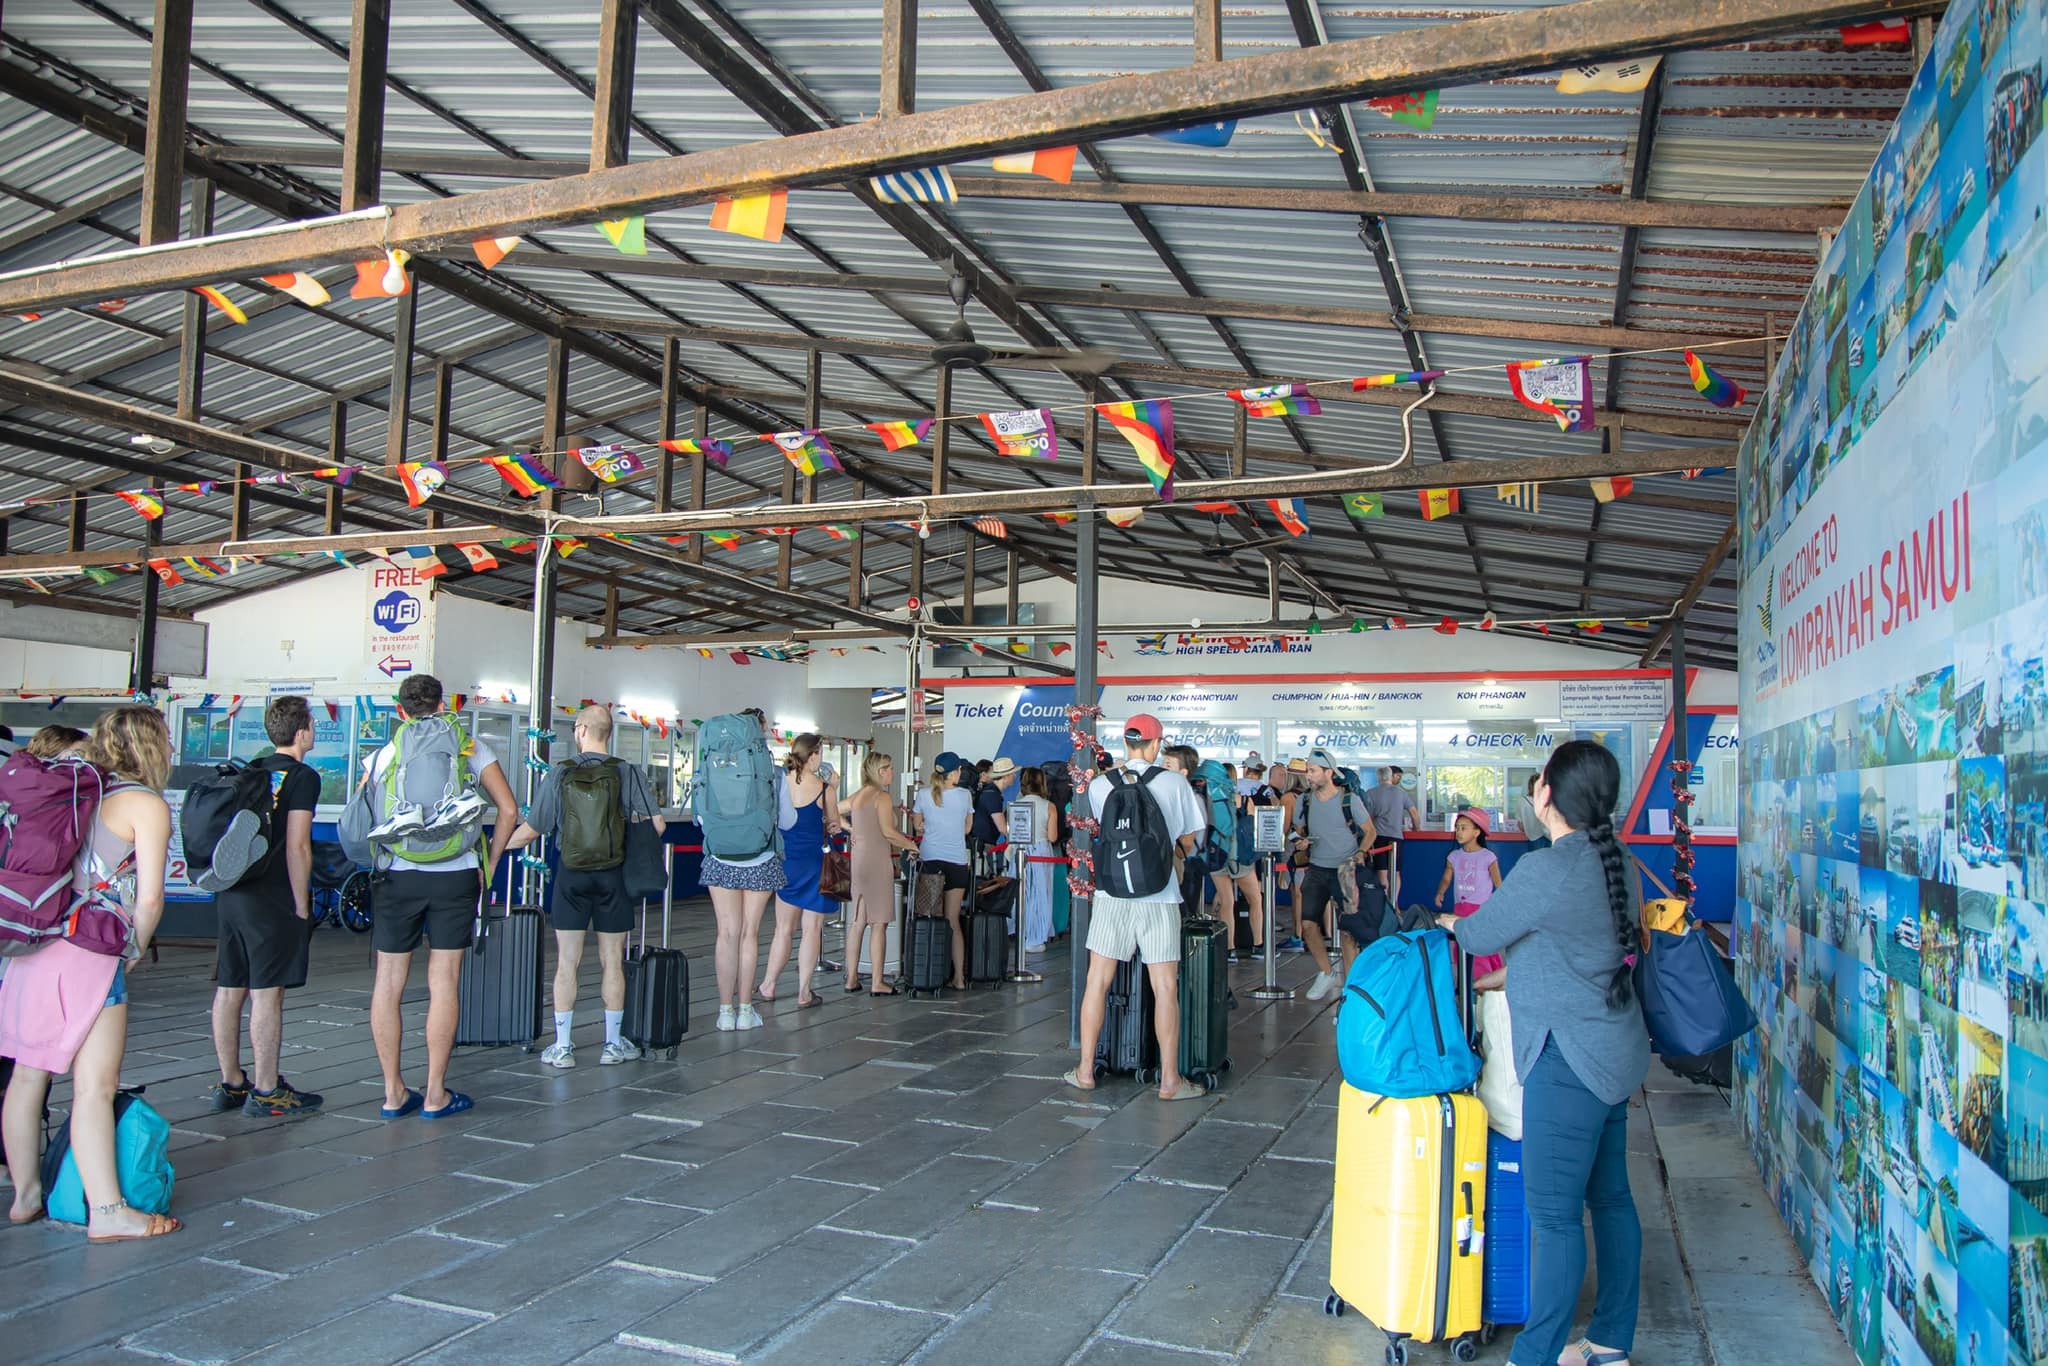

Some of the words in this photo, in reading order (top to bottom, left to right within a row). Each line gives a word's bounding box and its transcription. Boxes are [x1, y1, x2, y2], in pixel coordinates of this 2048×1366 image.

[1780, 530, 1821, 608] WELCOME
[1822, 514, 1838, 569] TO
[375, 568, 422, 588] FREE
[1780, 564, 1874, 688] LOMPRAYAH
[1881, 491, 1971, 635] SAMUI
[1175, 646, 1203, 655] HIGH
[1206, 645, 1241, 655] SPEED
[1243, 644, 1312, 654] CATAMRAN
[1127, 694, 1145, 702] KOH
[1146, 694, 1163, 702] TAO
[1170, 694, 1189, 702] KOH
[1190, 693, 1239, 701] NANGYUAN
[1272, 693, 1323, 701] CHUMPHON
[1330, 692, 1370, 700] HUA-HIN
[1378, 692, 1423, 700] BANGKOK
[1456, 691, 1478, 700] KOH
[1479, 691, 1527, 699] PHANGAN
[954, 703, 1005, 718] Ticket
[1297, 735, 1308, 747] 3
[1314, 734, 1397, 747] CHECK-IN
[1448, 734, 1459, 747] 4
[1465, 734, 1553, 747] CHECK-IN
[1115, 818, 1130, 830] JM
